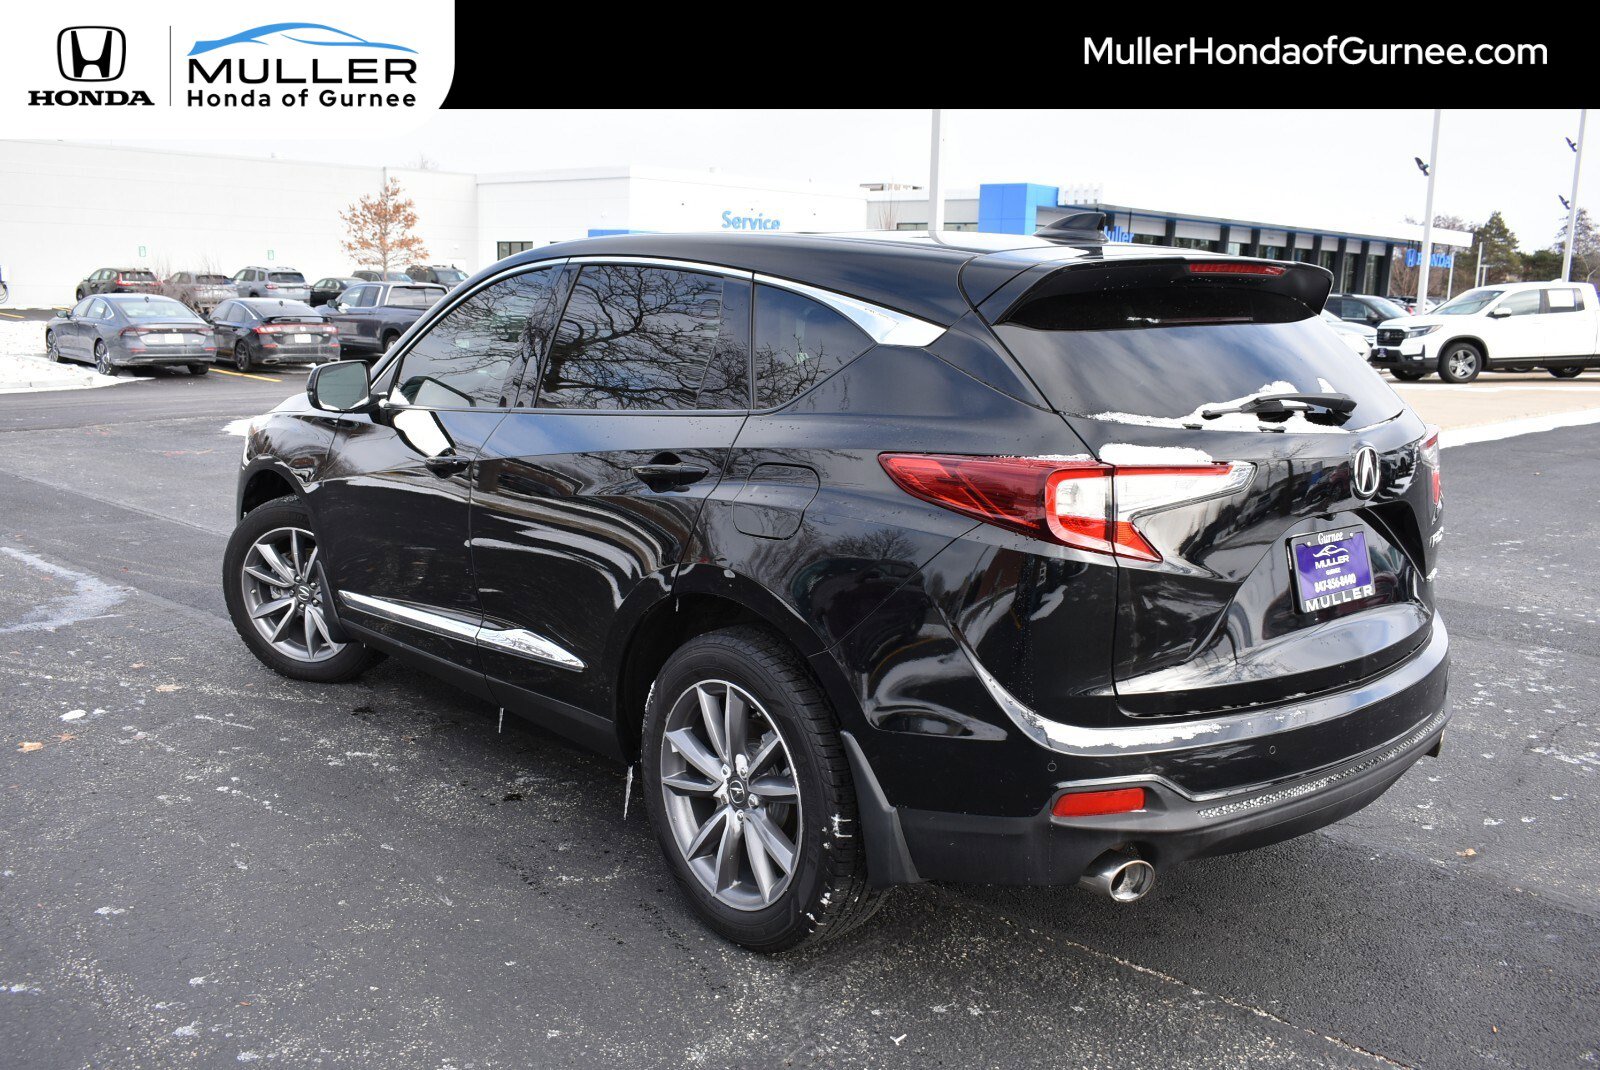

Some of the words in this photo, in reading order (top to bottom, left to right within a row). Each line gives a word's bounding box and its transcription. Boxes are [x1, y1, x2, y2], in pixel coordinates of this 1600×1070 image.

[721, 210, 781, 231] Service
[1103, 225, 1135, 243] uller
[1317, 531, 1344, 545] Gurnee
[1314, 554, 1350, 570] MULLER
[1305, 584, 1374, 613] MULLER
